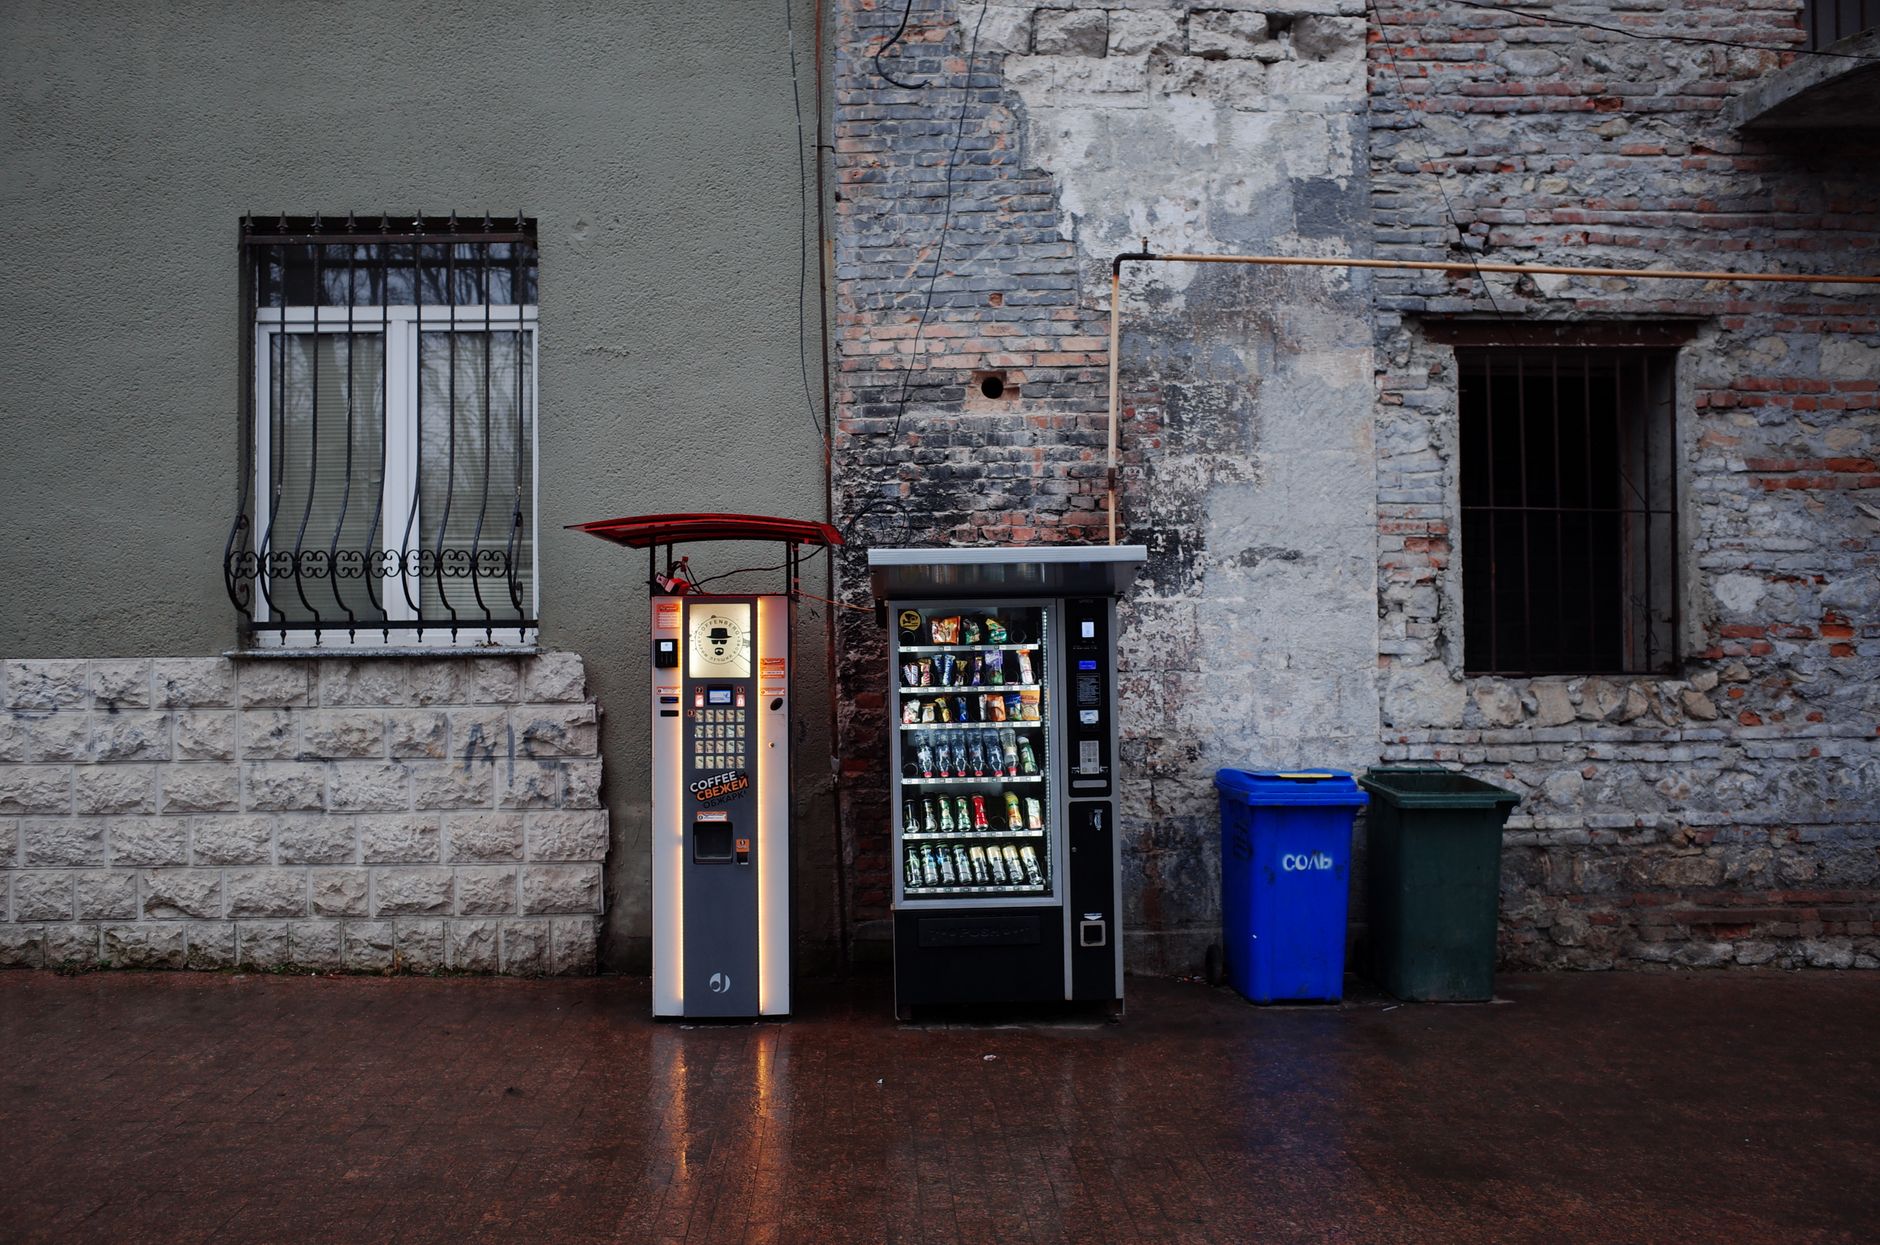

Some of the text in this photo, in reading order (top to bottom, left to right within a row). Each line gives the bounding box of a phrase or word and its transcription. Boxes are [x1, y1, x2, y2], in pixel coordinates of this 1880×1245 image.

[690, 771, 737, 792] COFFEE
[697, 776, 748, 801] СВЕЖЕЙ
[703, 790, 746, 808] ОБЖАРК
[1282, 853, 1333, 871] СОЛЬ
